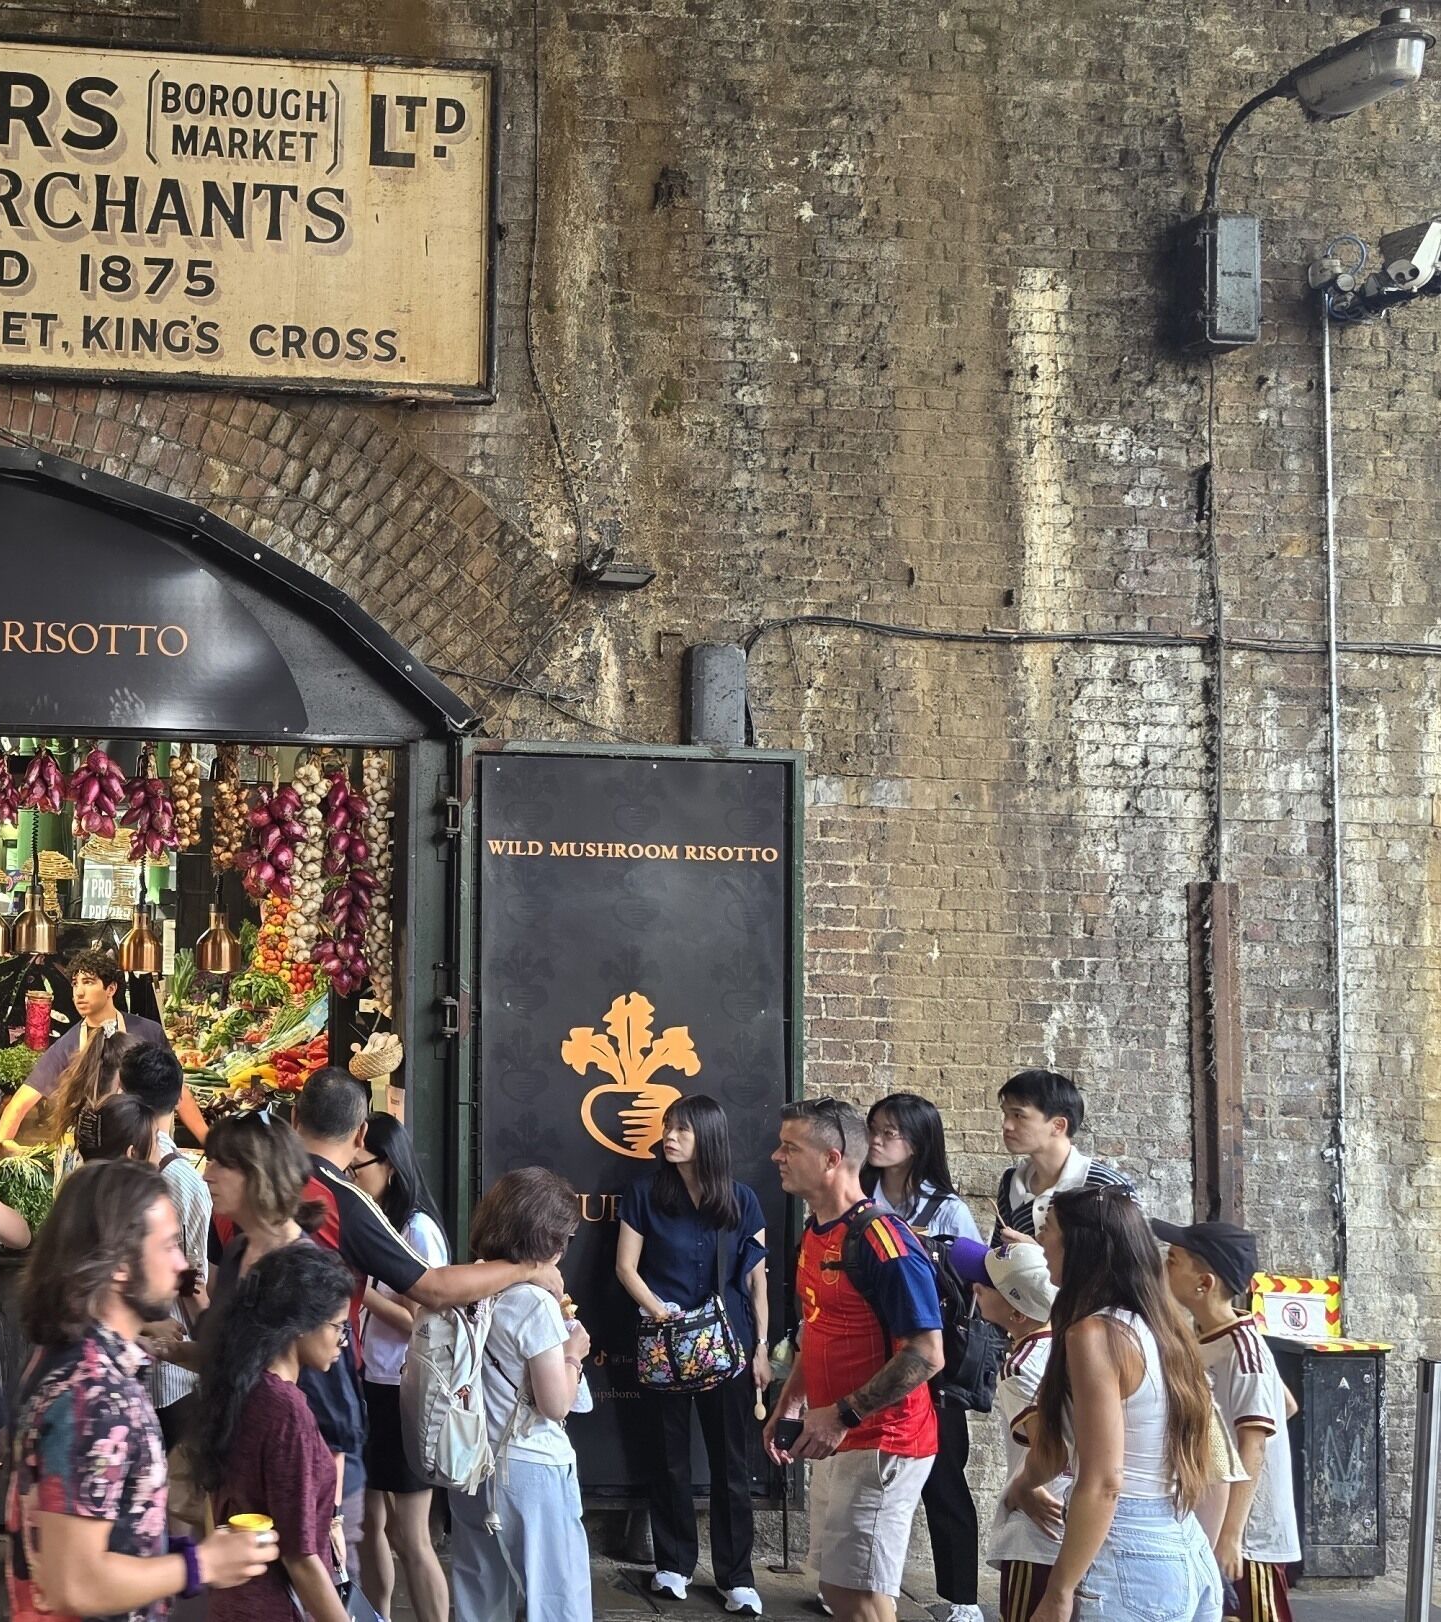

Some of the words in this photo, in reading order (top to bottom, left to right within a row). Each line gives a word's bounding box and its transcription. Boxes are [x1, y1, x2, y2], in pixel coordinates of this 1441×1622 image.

[80, 254, 215, 297] 1875
[83, 316, 219, 356] KING'S
[250, 325, 406, 364] CROSS.
[2, 619, 189, 657] RISOTTO
[487, 839, 544, 856] WILD
[549, 841, 679, 861] MUSHROOM
[684, 844, 779, 863] RISOTTO
